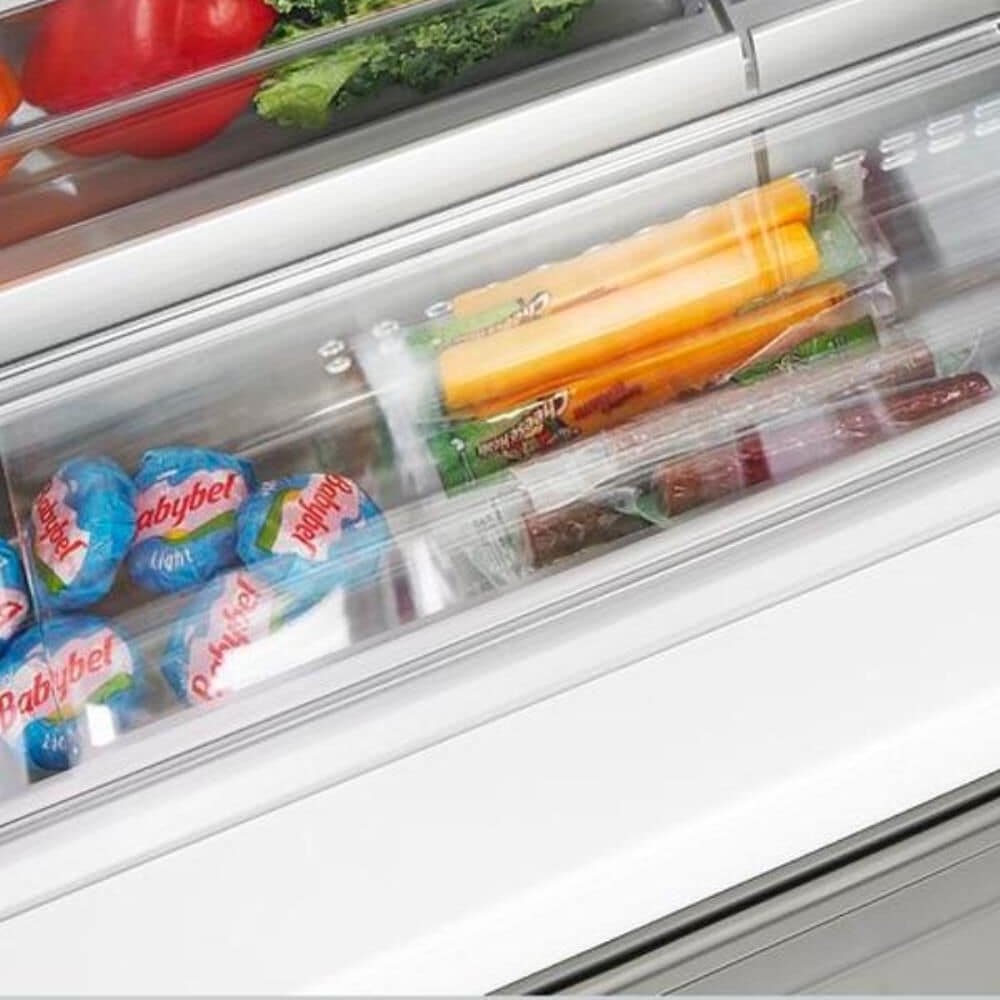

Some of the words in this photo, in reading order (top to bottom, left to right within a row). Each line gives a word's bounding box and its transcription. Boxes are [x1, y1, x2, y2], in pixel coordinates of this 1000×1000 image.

[36, 480, 87, 560] abybel
[292, 472, 353, 556] Babybel
[151, 547, 193, 571] Light
[0, 634, 114, 731] Babybel
